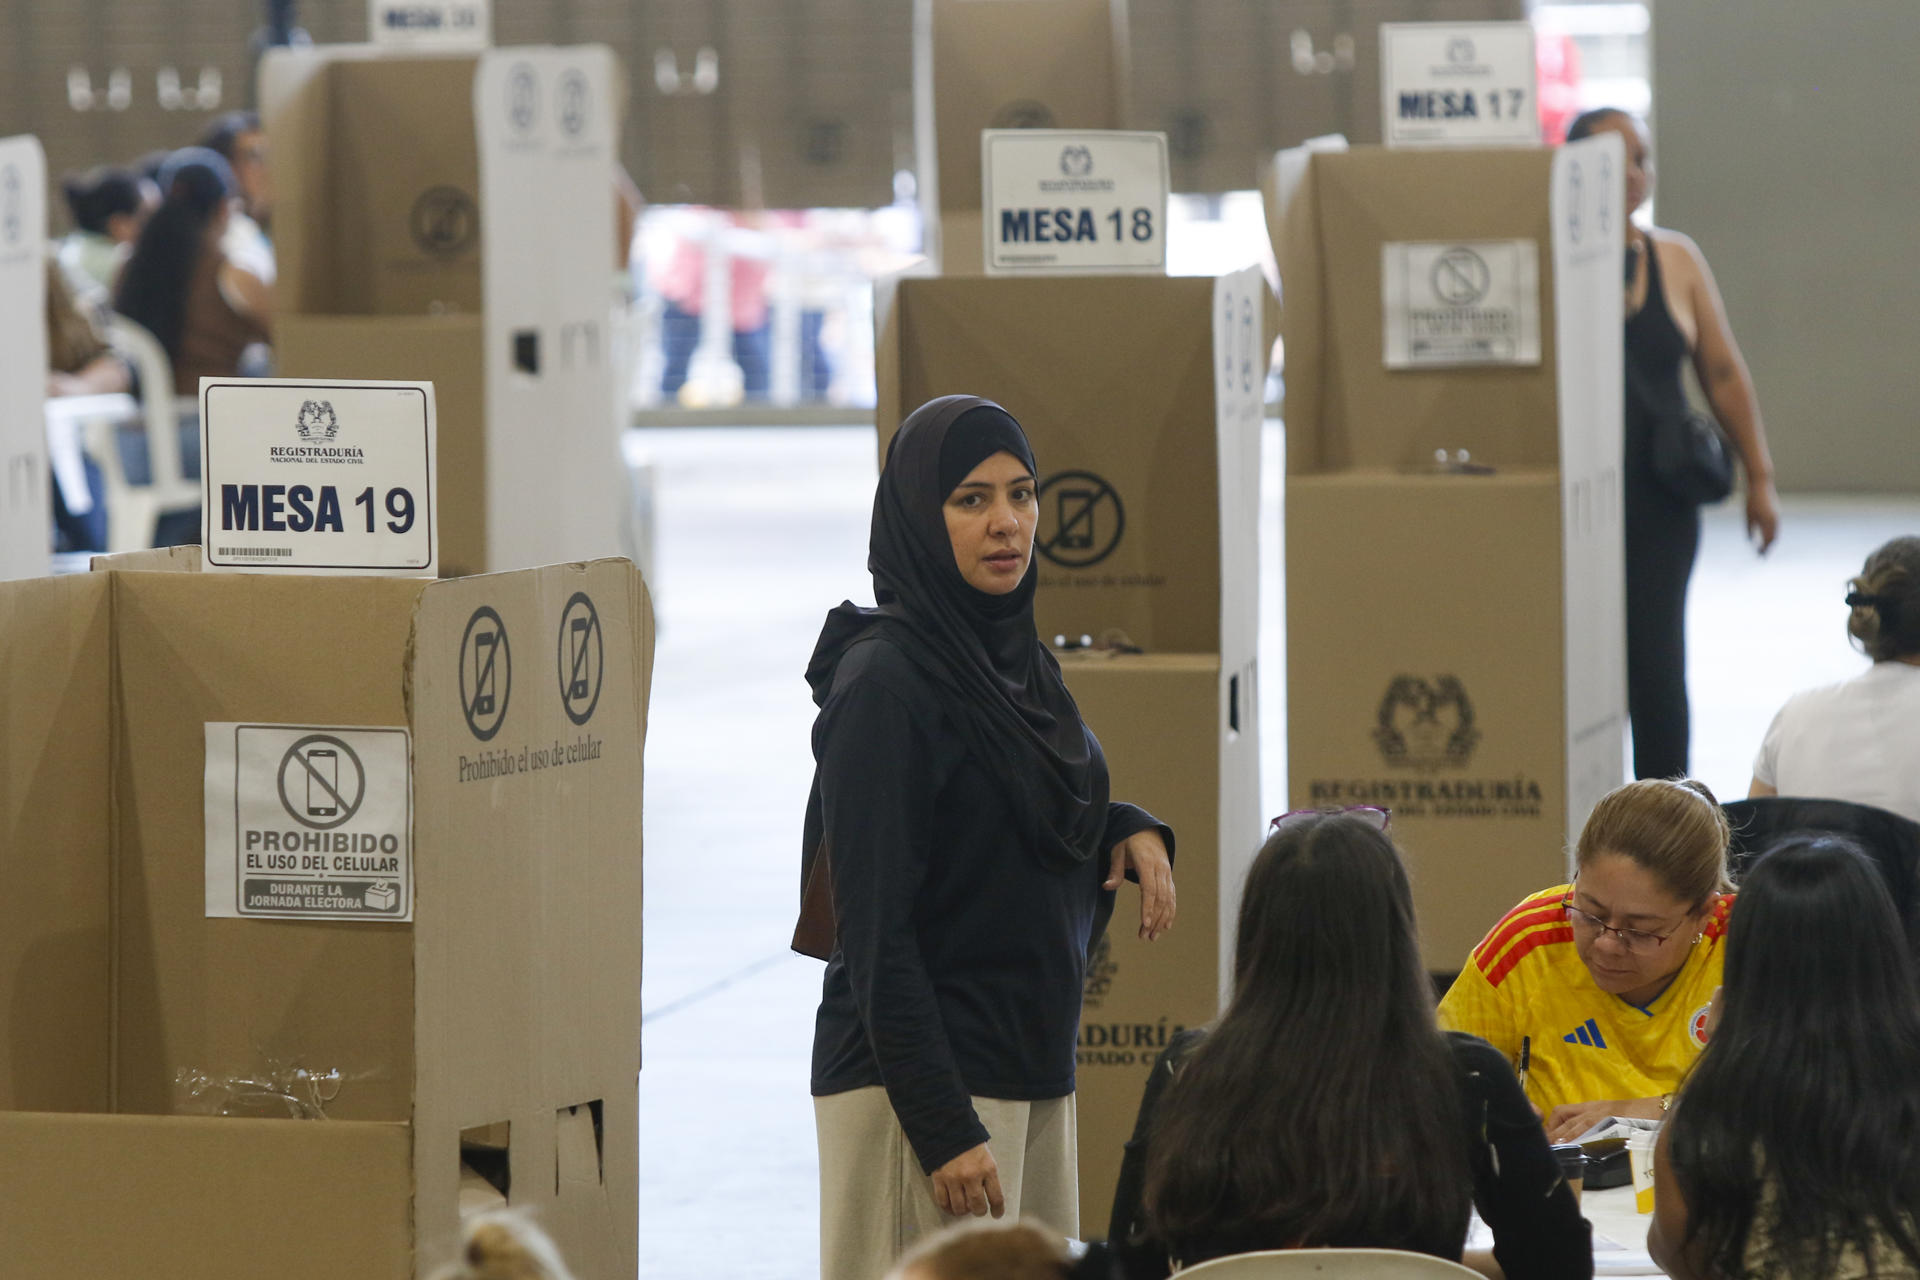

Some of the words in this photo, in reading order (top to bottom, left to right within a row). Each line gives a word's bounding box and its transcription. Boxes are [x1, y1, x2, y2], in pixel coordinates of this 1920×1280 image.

[1399, 89, 1477, 119] MESA
[1489, 88, 1524, 119] 17
[1001, 208, 1097, 243] MESA
[1107, 207, 1153, 242] 18
[270, 445, 364, 457] REGISTRADURÍA
[221, 484, 344, 532] MESA
[355, 486, 415, 534] 19
[459, 749, 515, 783] Prohibido
[518, 746, 528, 772] el
[531, 752, 550, 770] uso
[552, 740, 564, 767] de
[566, 734, 603, 762] celular
[245, 830, 399, 854] PROHIBIDO
[246, 854, 263, 869] EL
[267, 855, 297, 870] USO
[302, 856, 329, 871] DEL
[333, 856, 399, 873] CELULAR
[270, 883, 324, 897] DURANTE
[327, 884, 343, 897] LA
[248, 895, 301, 909] JORNADA
[304, 896, 363, 910] ELECTORA
